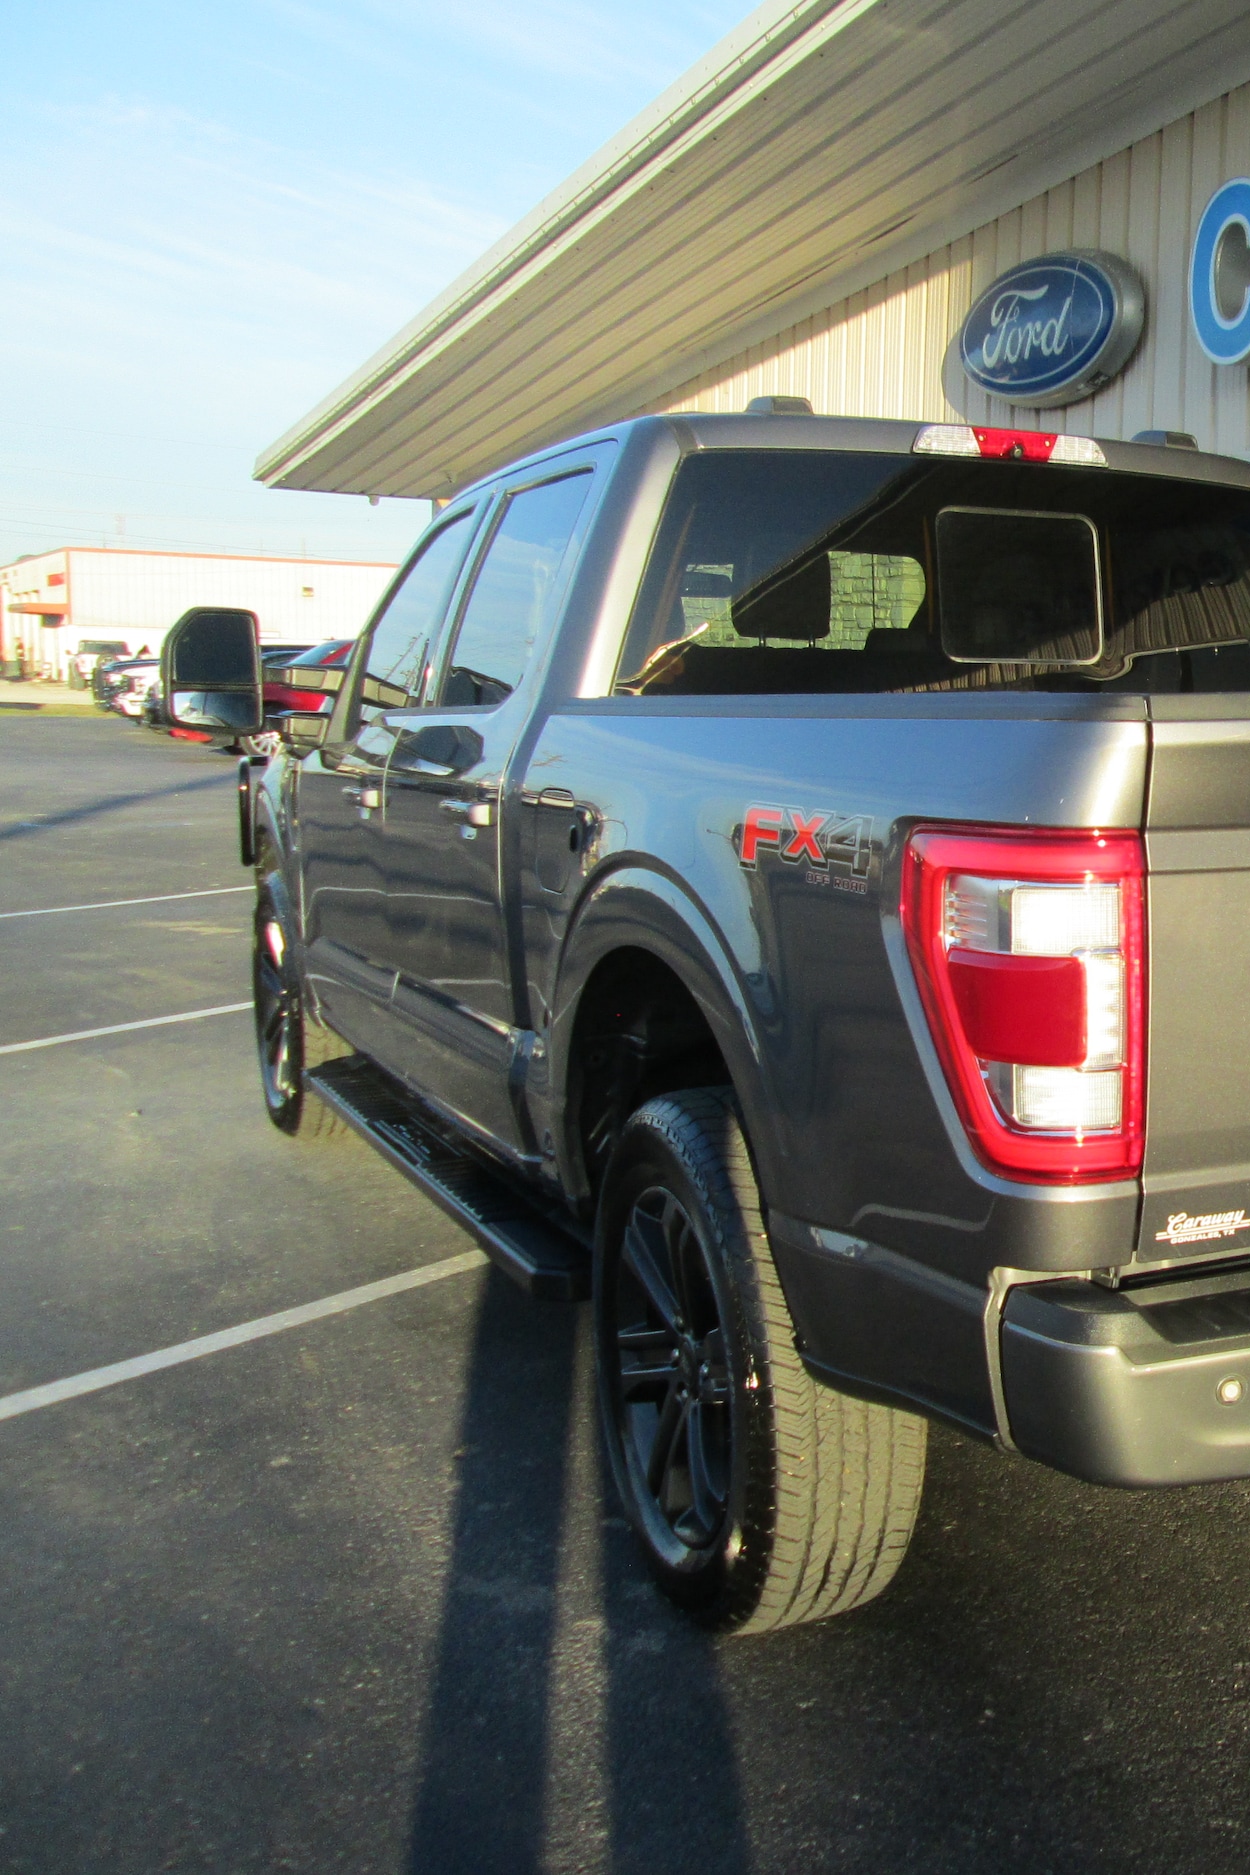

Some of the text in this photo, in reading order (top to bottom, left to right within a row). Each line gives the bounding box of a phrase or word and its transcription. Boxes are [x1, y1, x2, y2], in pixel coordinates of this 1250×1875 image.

[982, 284, 1072, 369] Ford
[738, 800, 875, 879] FX4
[805, 870, 868, 895] OFF ROAD
[1167, 1210, 1245, 1235] Caraway
[1170, 1231, 1221, 1244] GONZALES,
